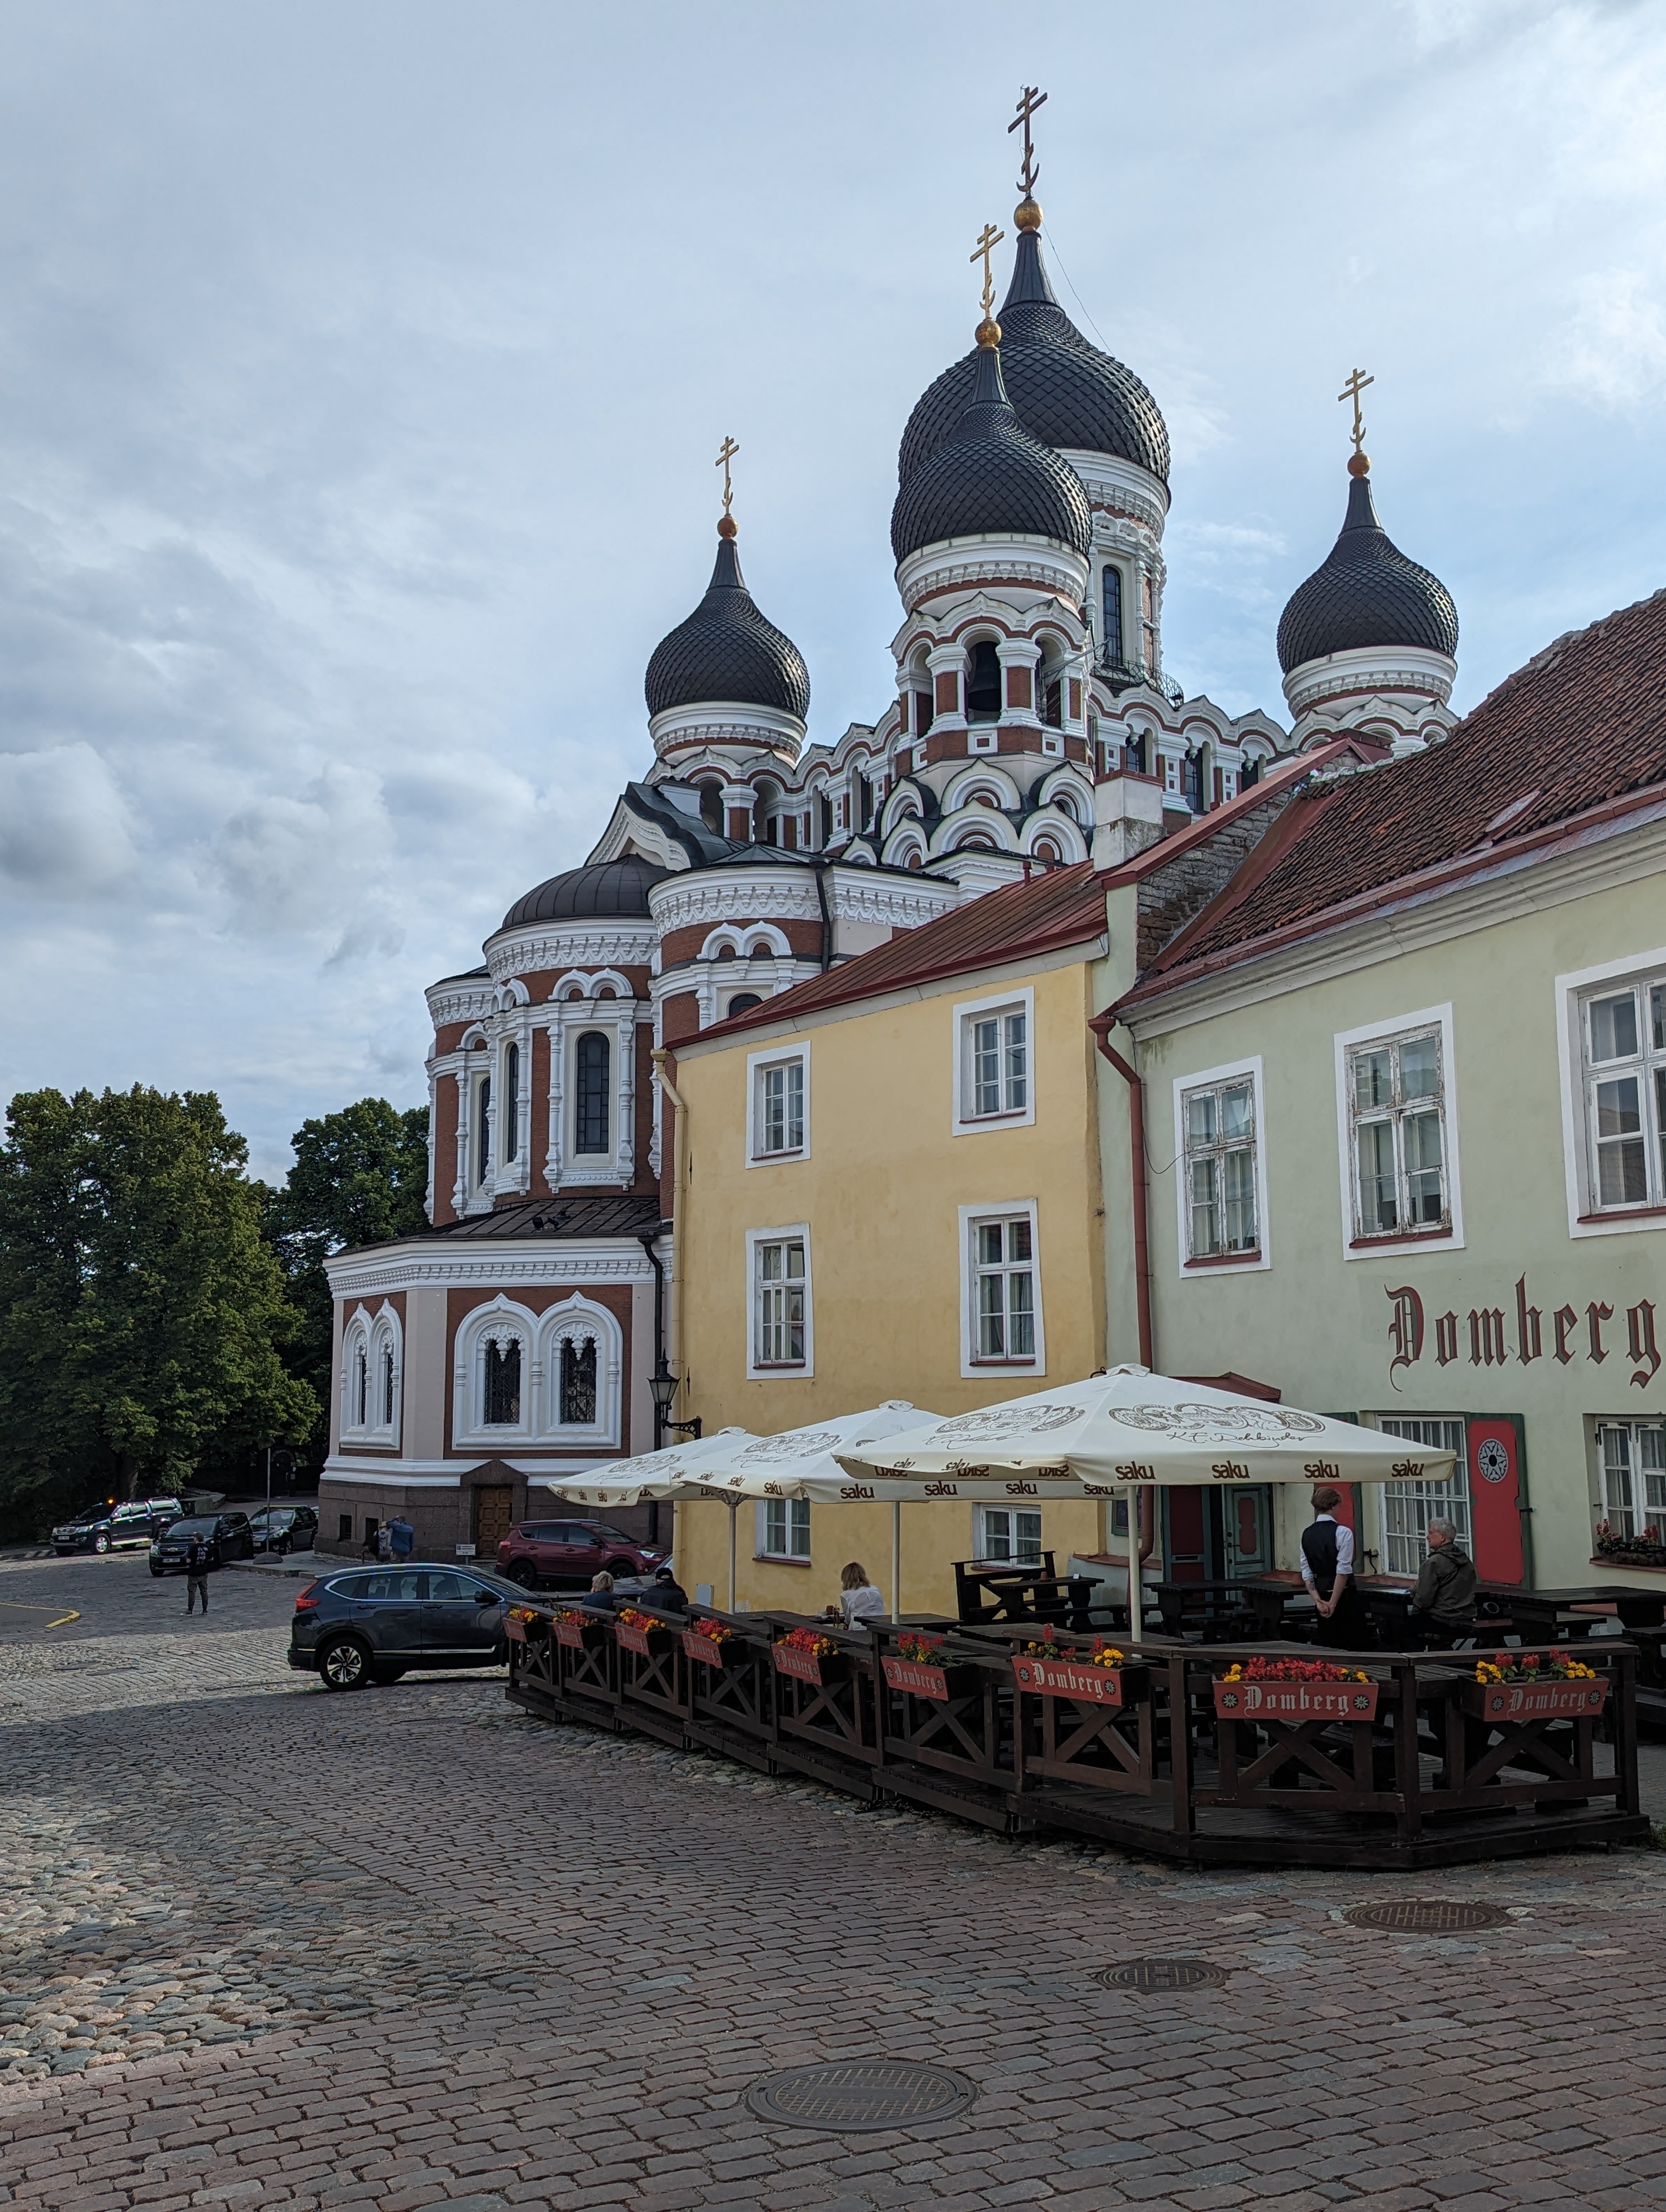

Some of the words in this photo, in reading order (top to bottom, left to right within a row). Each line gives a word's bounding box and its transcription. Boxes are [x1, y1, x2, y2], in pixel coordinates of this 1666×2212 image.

[1385, 1271, 1661, 1392] Domberg
[1115, 1461, 1156, 1481] saku
[1212, 1460, 1250, 1479] saku
[1304, 1459, 1340, 1478] saku
[1392, 1458, 1424, 1477] saku
[764, 1480, 784, 1495] saku
[840, 1483, 875, 1499] saku
[924, 1481, 958, 1495] saku
[1005, 1480, 1038, 1494] saku
[780, 1650, 813, 1679] Domberg
[893, 1663, 937, 1694] Domberg
[1030, 1661, 1104, 1700] Domberg
[1243, 1686, 1349, 1717] Domberg
[1507, 1687, 1586, 1719] Domberg
